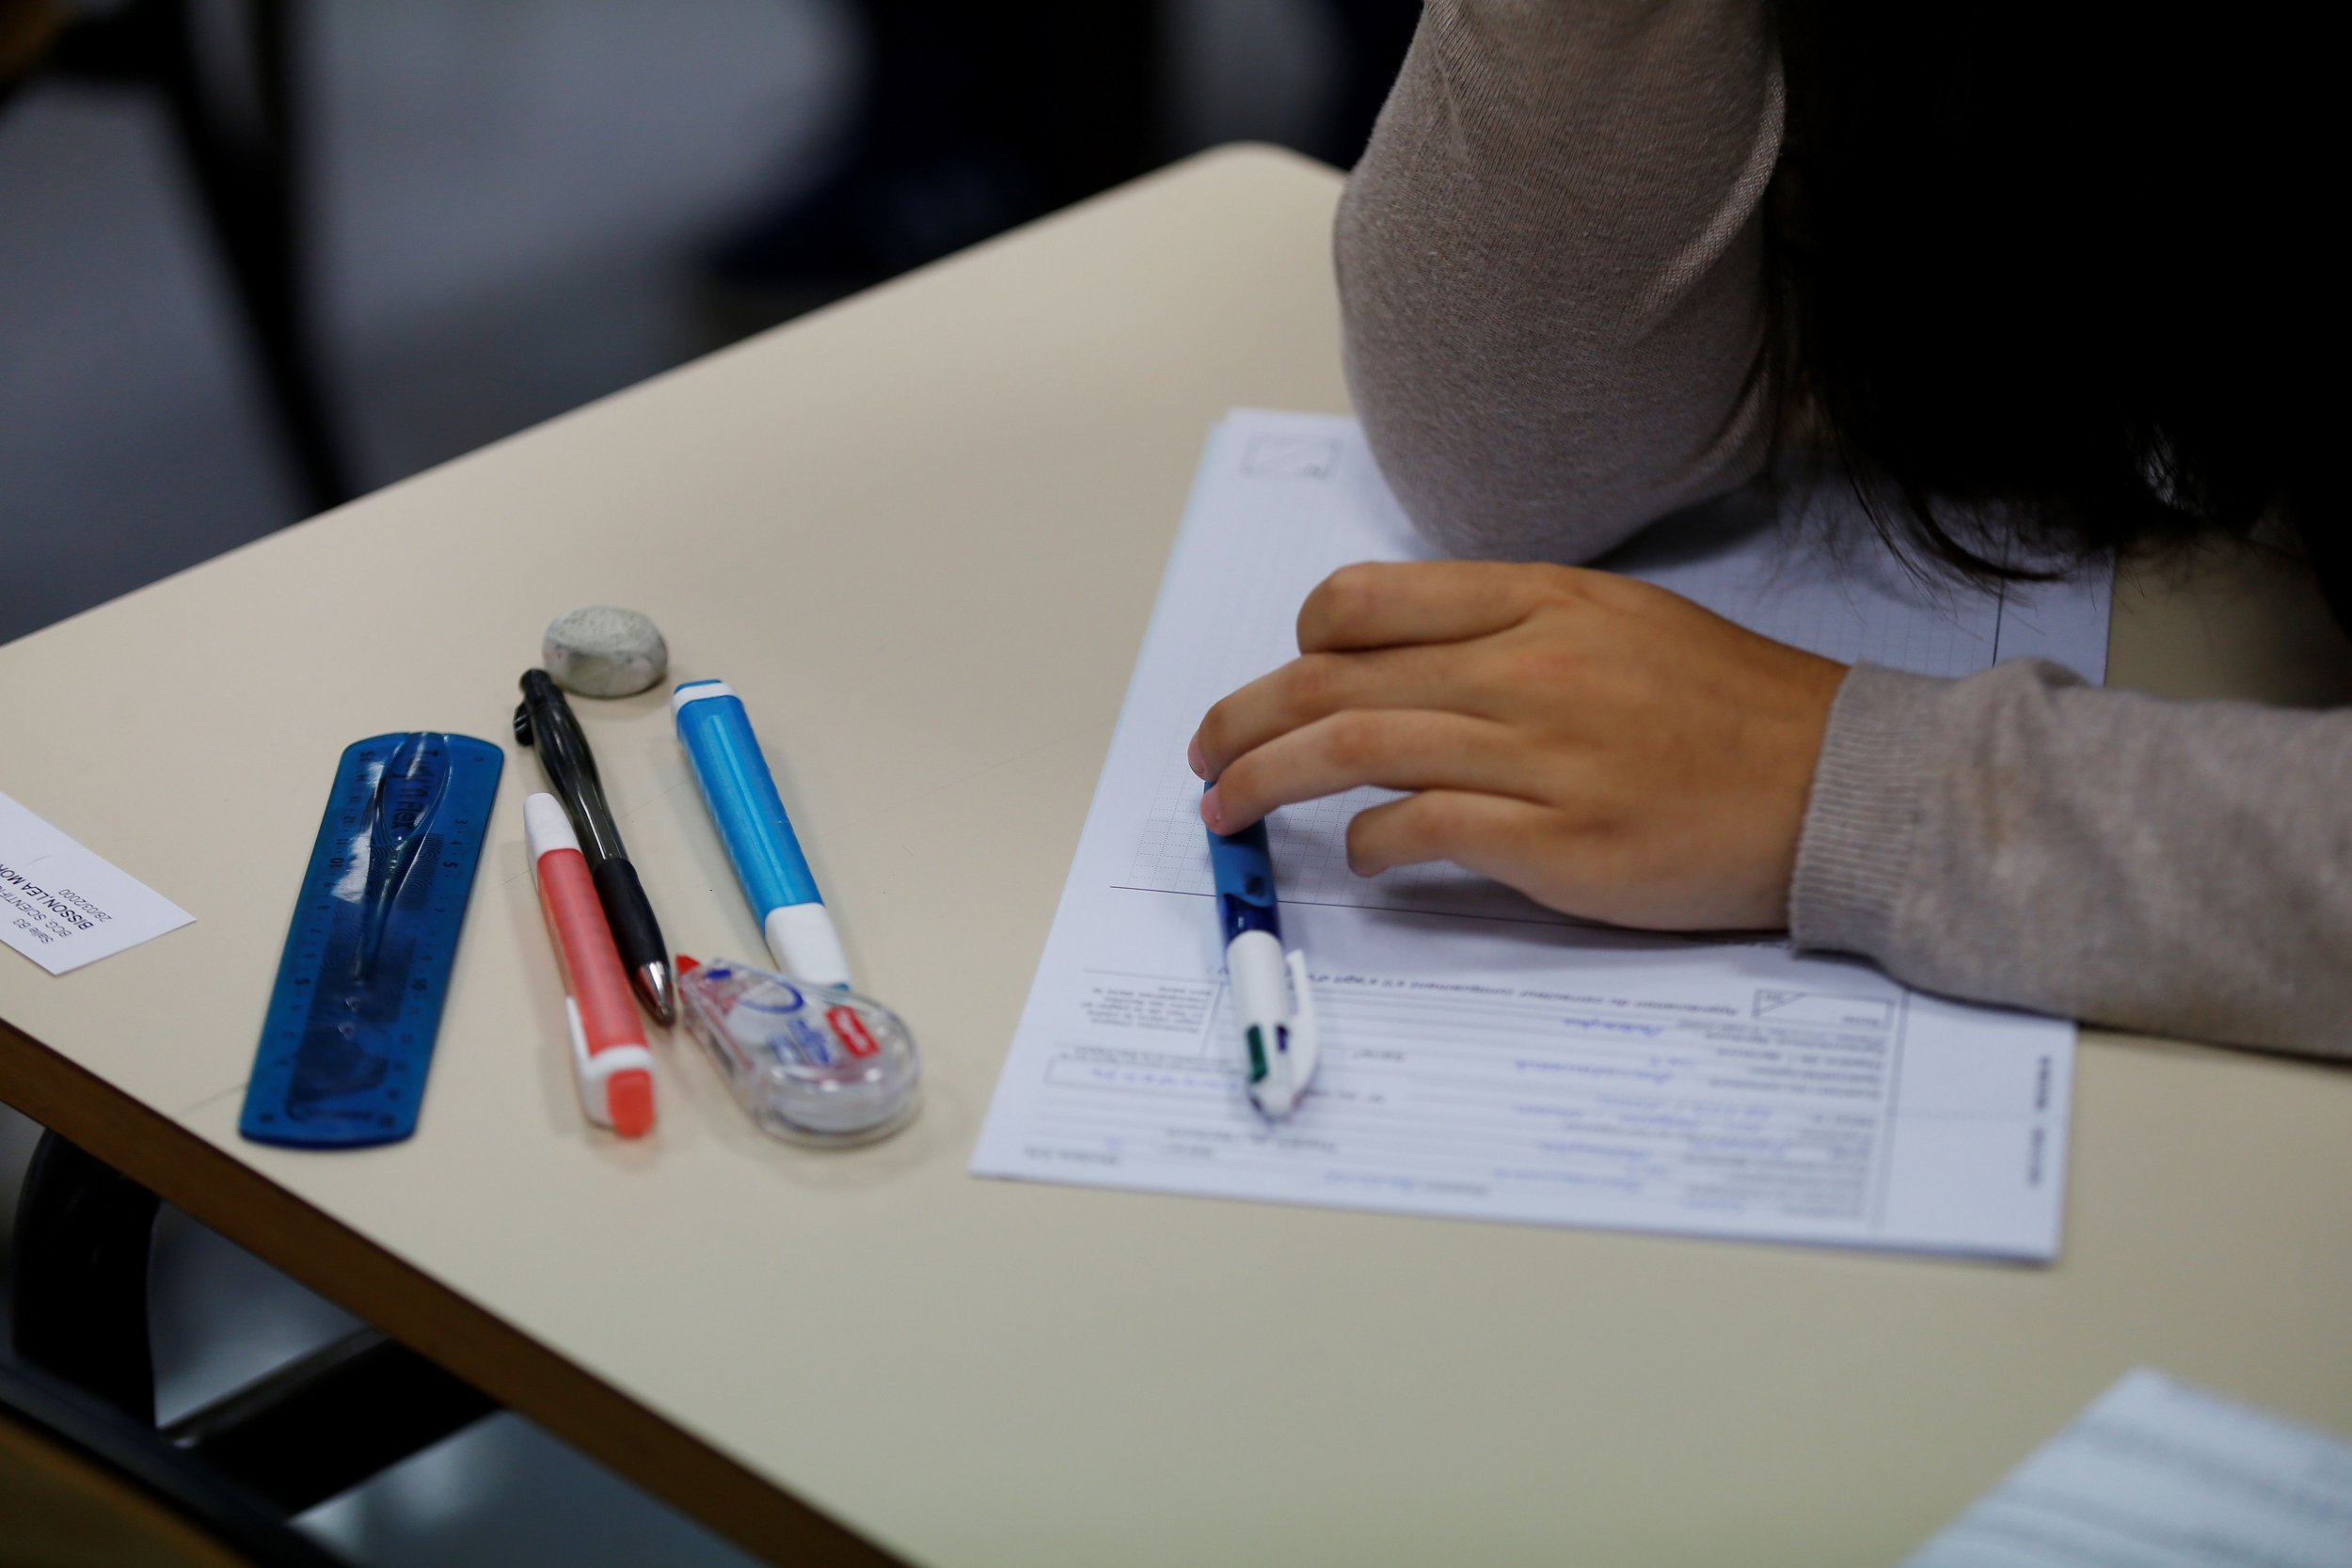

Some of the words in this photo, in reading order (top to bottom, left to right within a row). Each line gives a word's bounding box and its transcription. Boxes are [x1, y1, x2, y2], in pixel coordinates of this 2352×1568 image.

[329, 857, 344, 867] 10
[58, 889, 113, 923] 28/03/2000
[12, 918, 32, 929] B3
